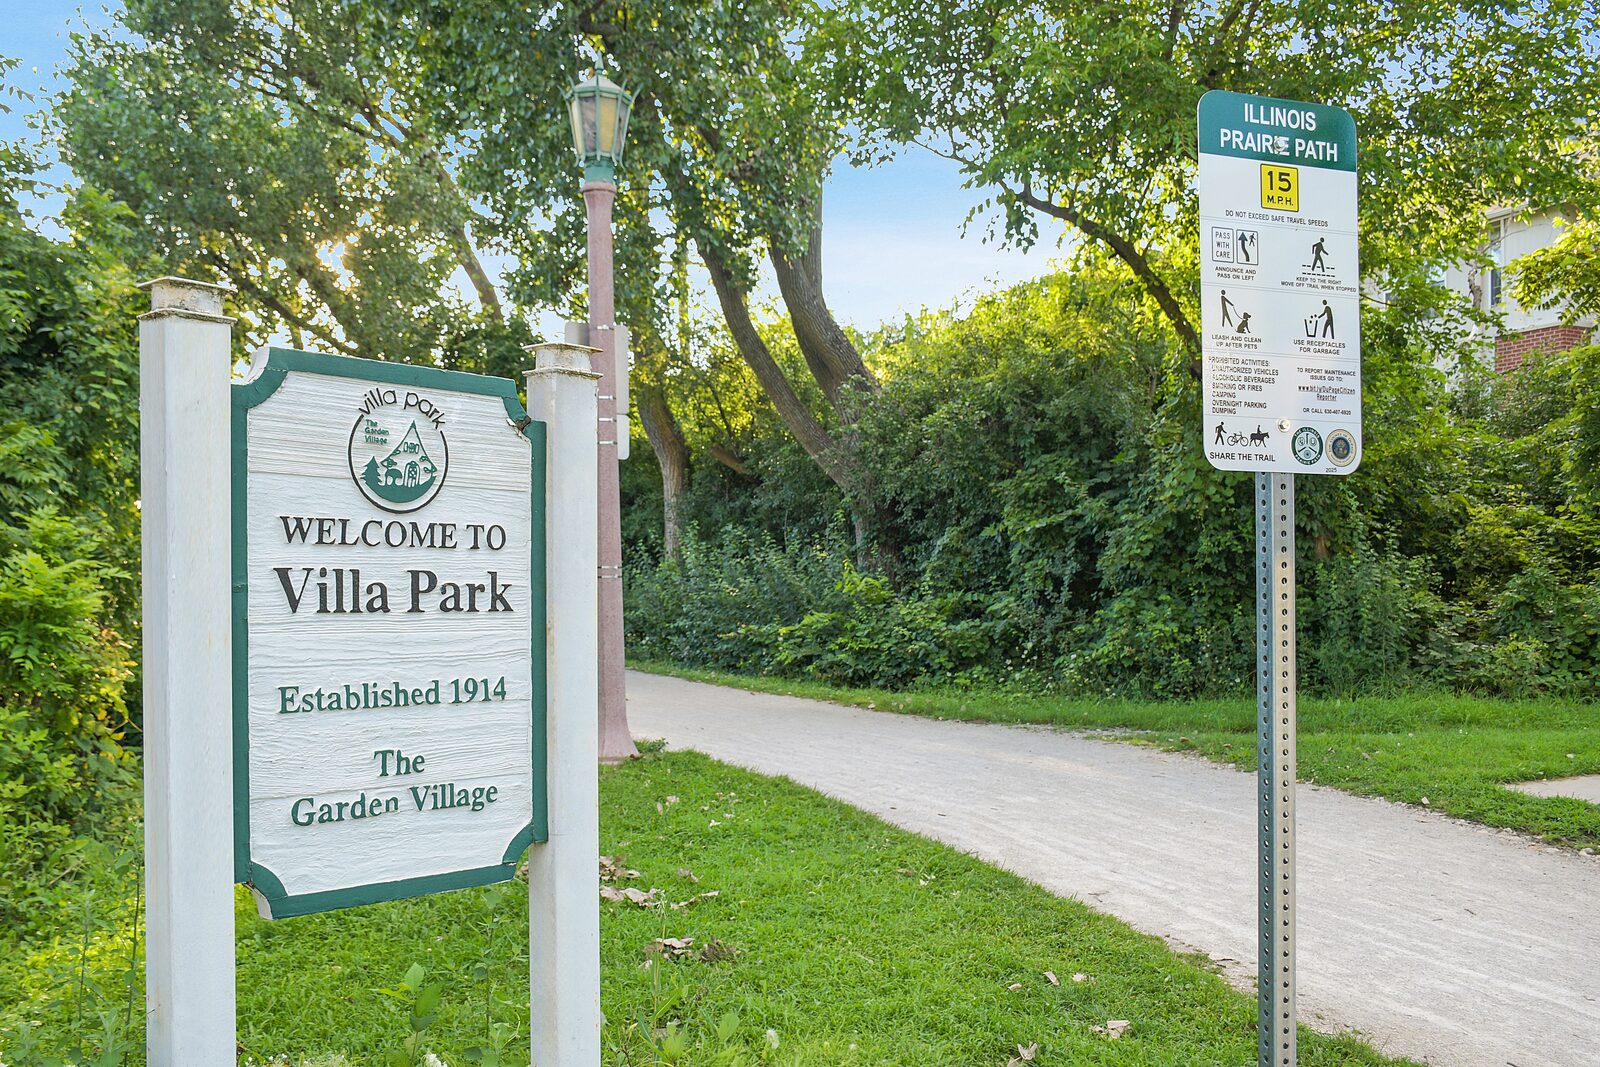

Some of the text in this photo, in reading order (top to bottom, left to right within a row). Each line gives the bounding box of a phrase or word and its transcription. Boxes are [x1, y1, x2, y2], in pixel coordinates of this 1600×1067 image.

[1244, 102, 1316, 131] ILLINOIS
[1295, 138, 1338, 162] PATH
[1267, 170, 1292, 192] 15
[1267, 195, 1294, 206] M.P.H.
[1248, 212, 1269, 220] EXCEED
[1308, 219, 1328, 227] SPEEDS
[1208, 356, 1239, 365] PROHIBITED
[1212, 366, 1252, 374] UNAUTHORIZED
[1244, 376, 1275, 384] BEVERAGES
[358, 388, 445, 430] villa park
[365, 427, 389, 435] Garden
[365, 435, 388, 444] Village
[1210, 452, 1235, 460] SHARE
[1254, 454, 1275, 462] TRAIL
[280, 516, 507, 550] WELCOME TO
[273, 567, 514, 614] Villa Park
[278, 676, 507, 714] Established 1914
[374, 750, 425, 777] The
[291, 783, 498, 826] Garden Village
